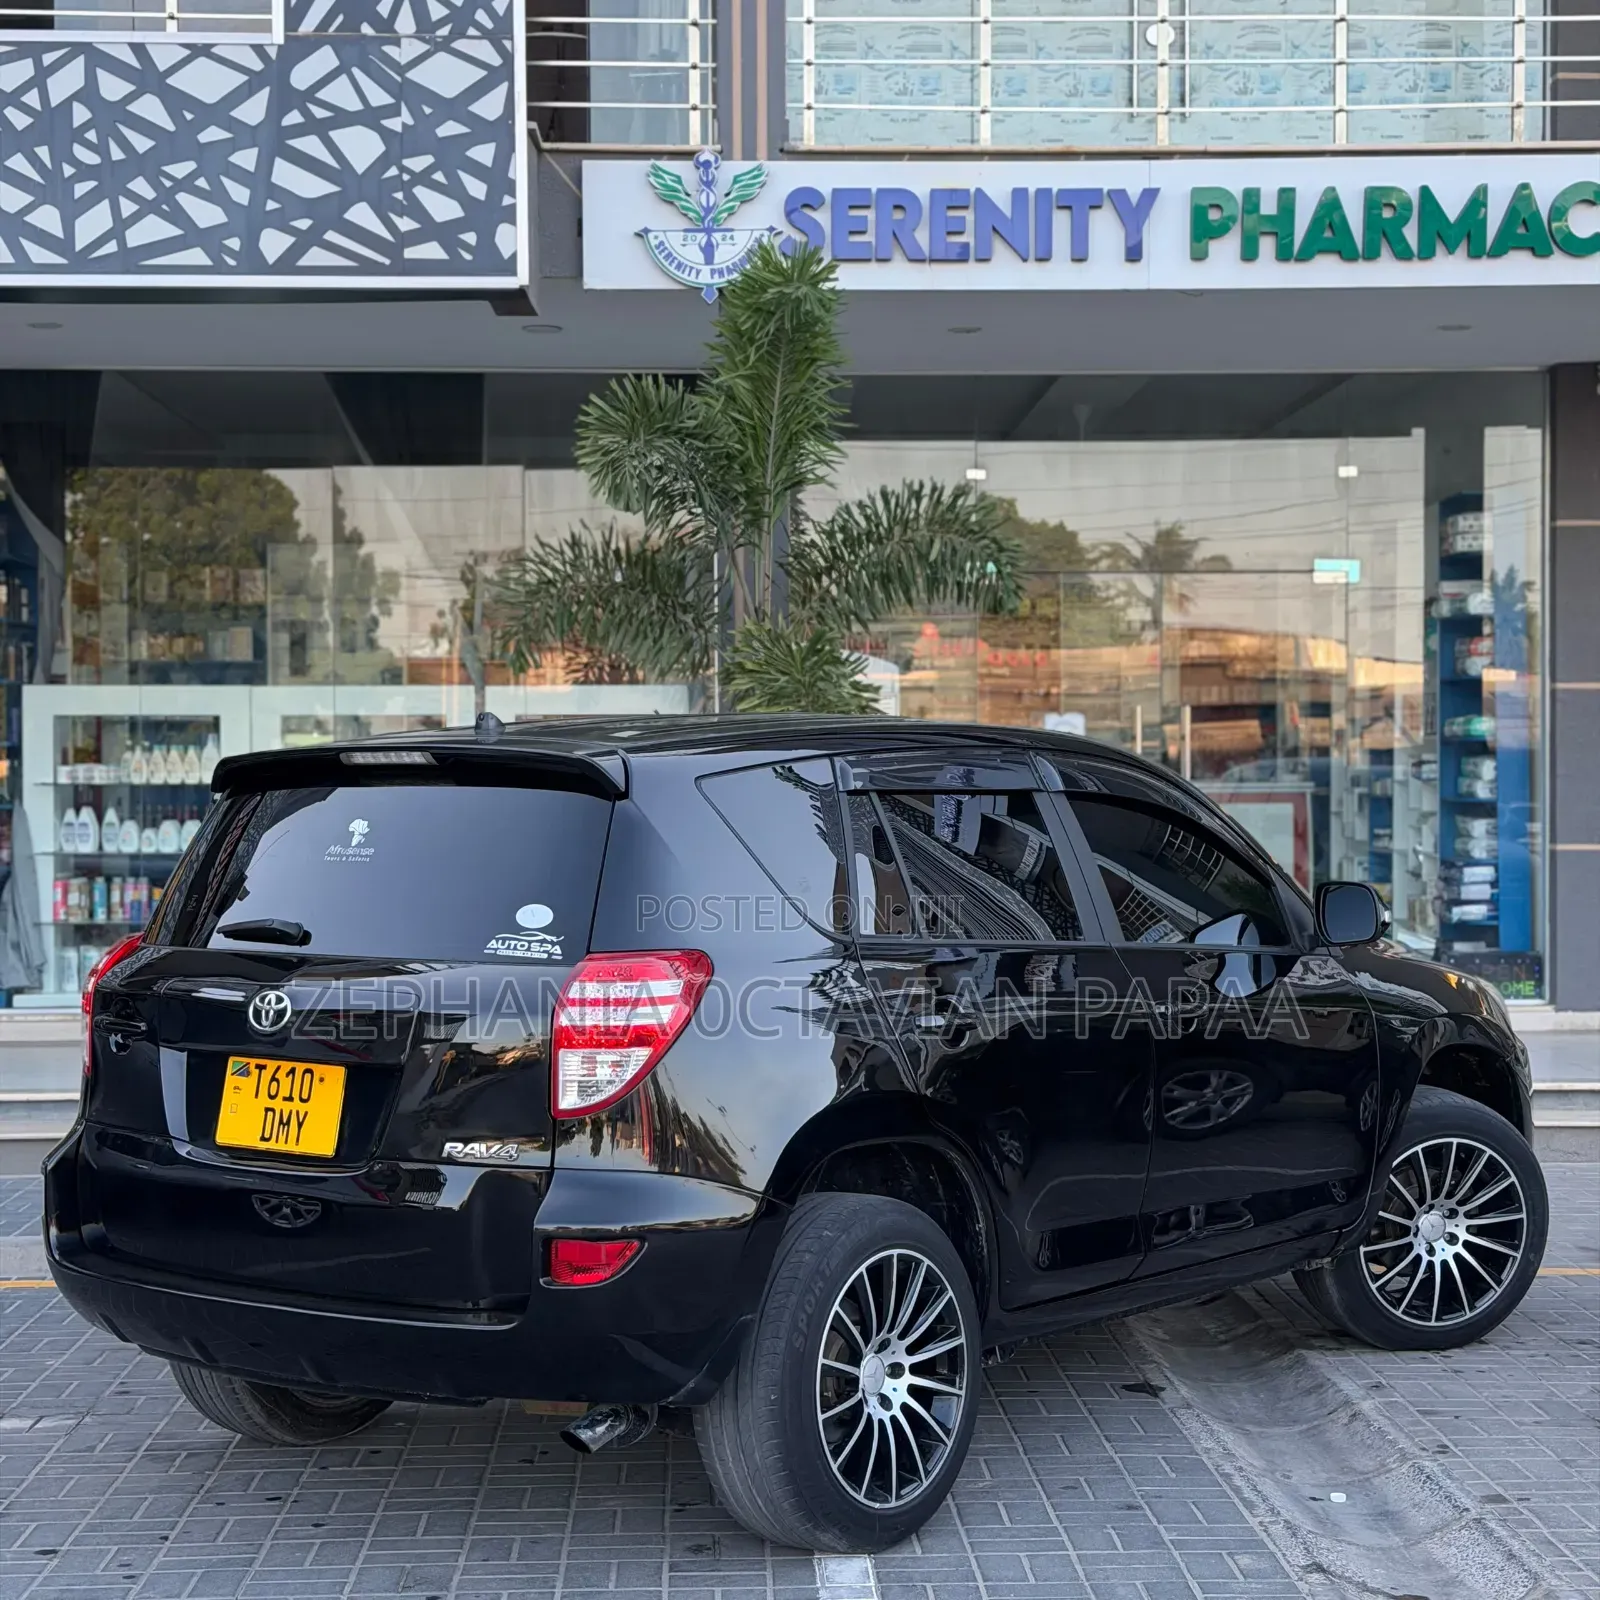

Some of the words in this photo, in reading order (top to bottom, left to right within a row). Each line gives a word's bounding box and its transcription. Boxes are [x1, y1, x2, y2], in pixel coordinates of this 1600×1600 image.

[779, 186, 1161, 263] SERENITY
[1189, 181, 1600, 261] PHARMAC
[654, 240, 702, 280] SERENITY
[486, 939, 529, 951] AUTO
[530, 942, 562, 954] SPA
[254, 1063, 315, 1104] T610
[259, 1106, 309, 1146] DMY
[441, 1142, 519, 1161] RAV4
